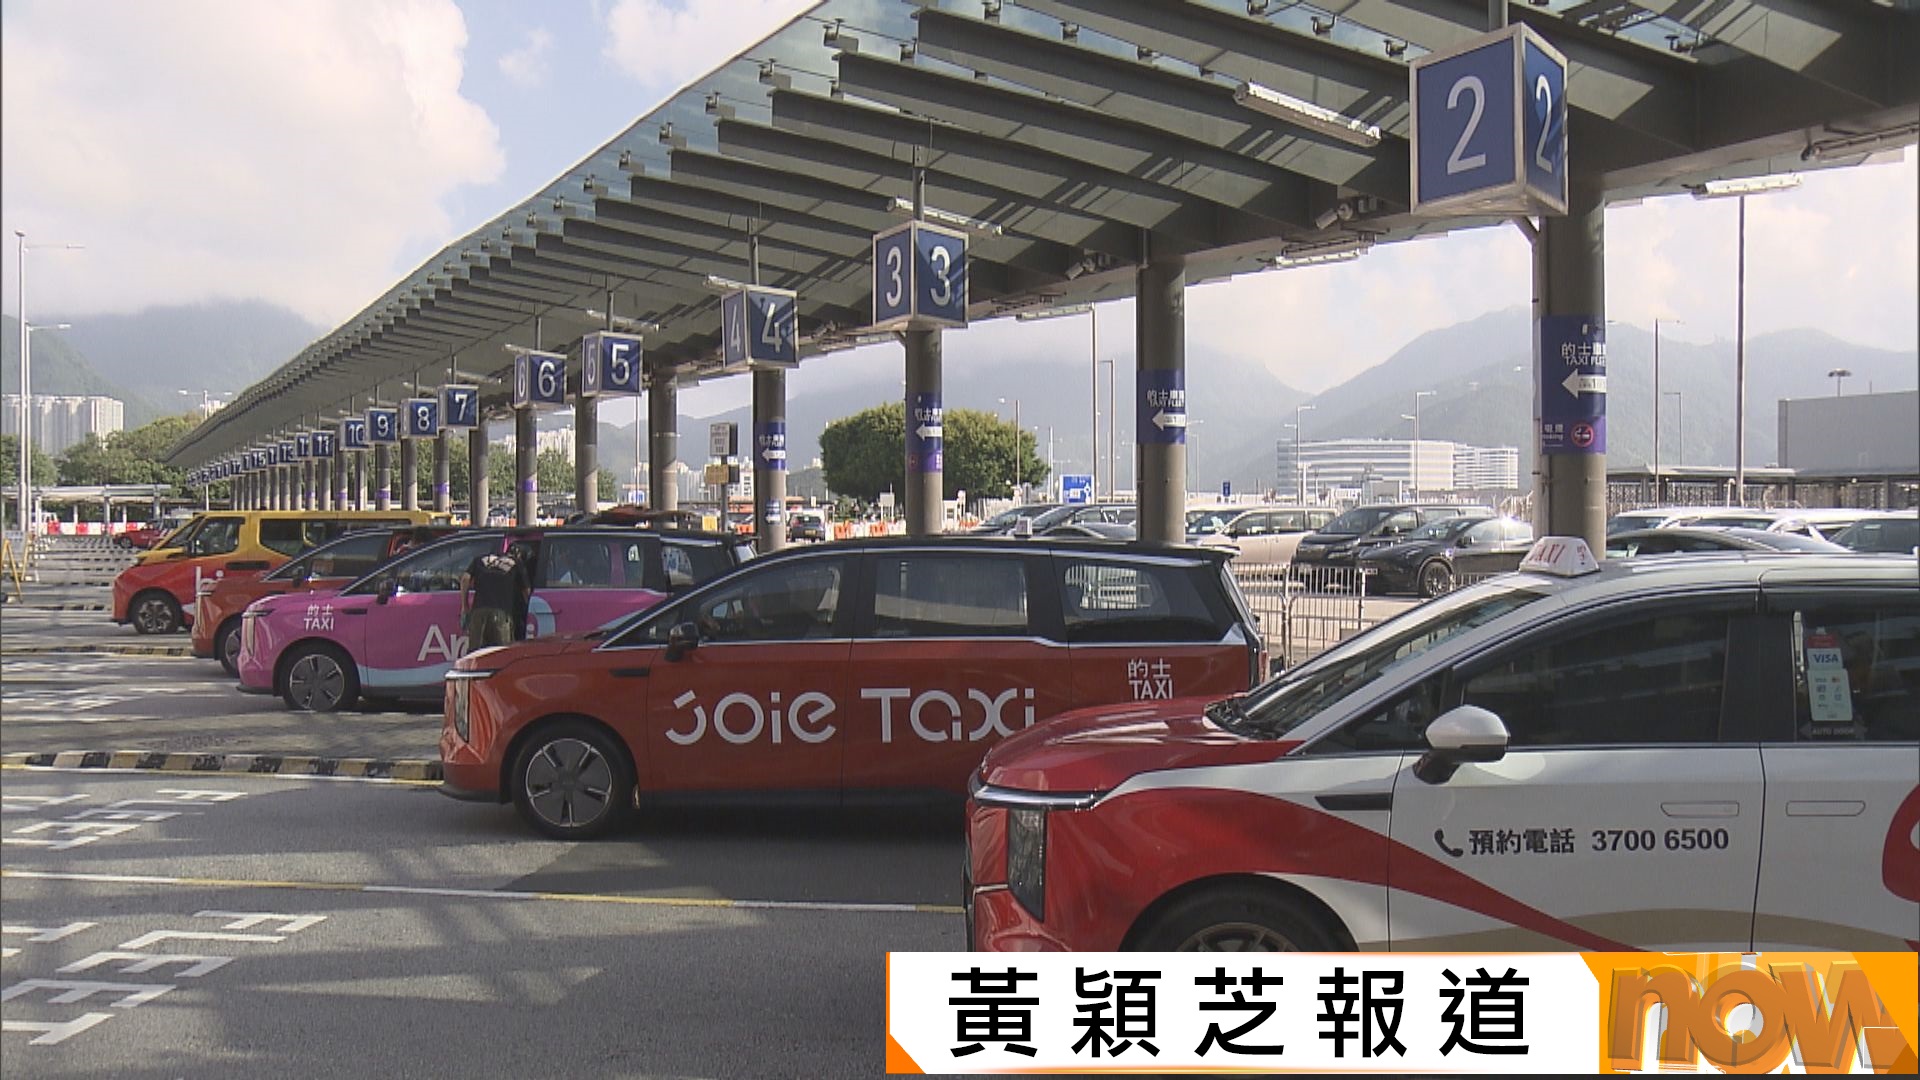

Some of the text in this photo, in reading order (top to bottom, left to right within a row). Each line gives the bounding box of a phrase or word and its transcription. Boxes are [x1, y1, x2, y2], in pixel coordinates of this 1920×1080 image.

[1447, 75, 1486, 176] 2
[1535, 73, 1553, 174] 2
[885, 246, 902, 308] 3
[929, 245, 951, 307] 3
[729, 303, 741, 353] 4
[760, 302, 782, 353] 4
[587, 343, 597, 386] 5
[611, 342, 630, 385] 5
[1565, 356, 1588, 366] TAXI
[538, 360, 556, 398] 6
[417, 405, 430, 432] 8
[454, 393, 469, 422] 7
[348, 423, 364, 445] 10
[377, 414, 389, 438] 9
[317, 435, 329, 456] 11
[307, 603, 334, 616] 的士
[304, 617, 335, 632] TAXI
[1128, 658, 1171, 678] 的士
[1813, 653, 1839, 663] VISA
[1129, 679, 1174, 700] TAXI
[1469, 828, 1729, 855] 預約電話 3700 6500
